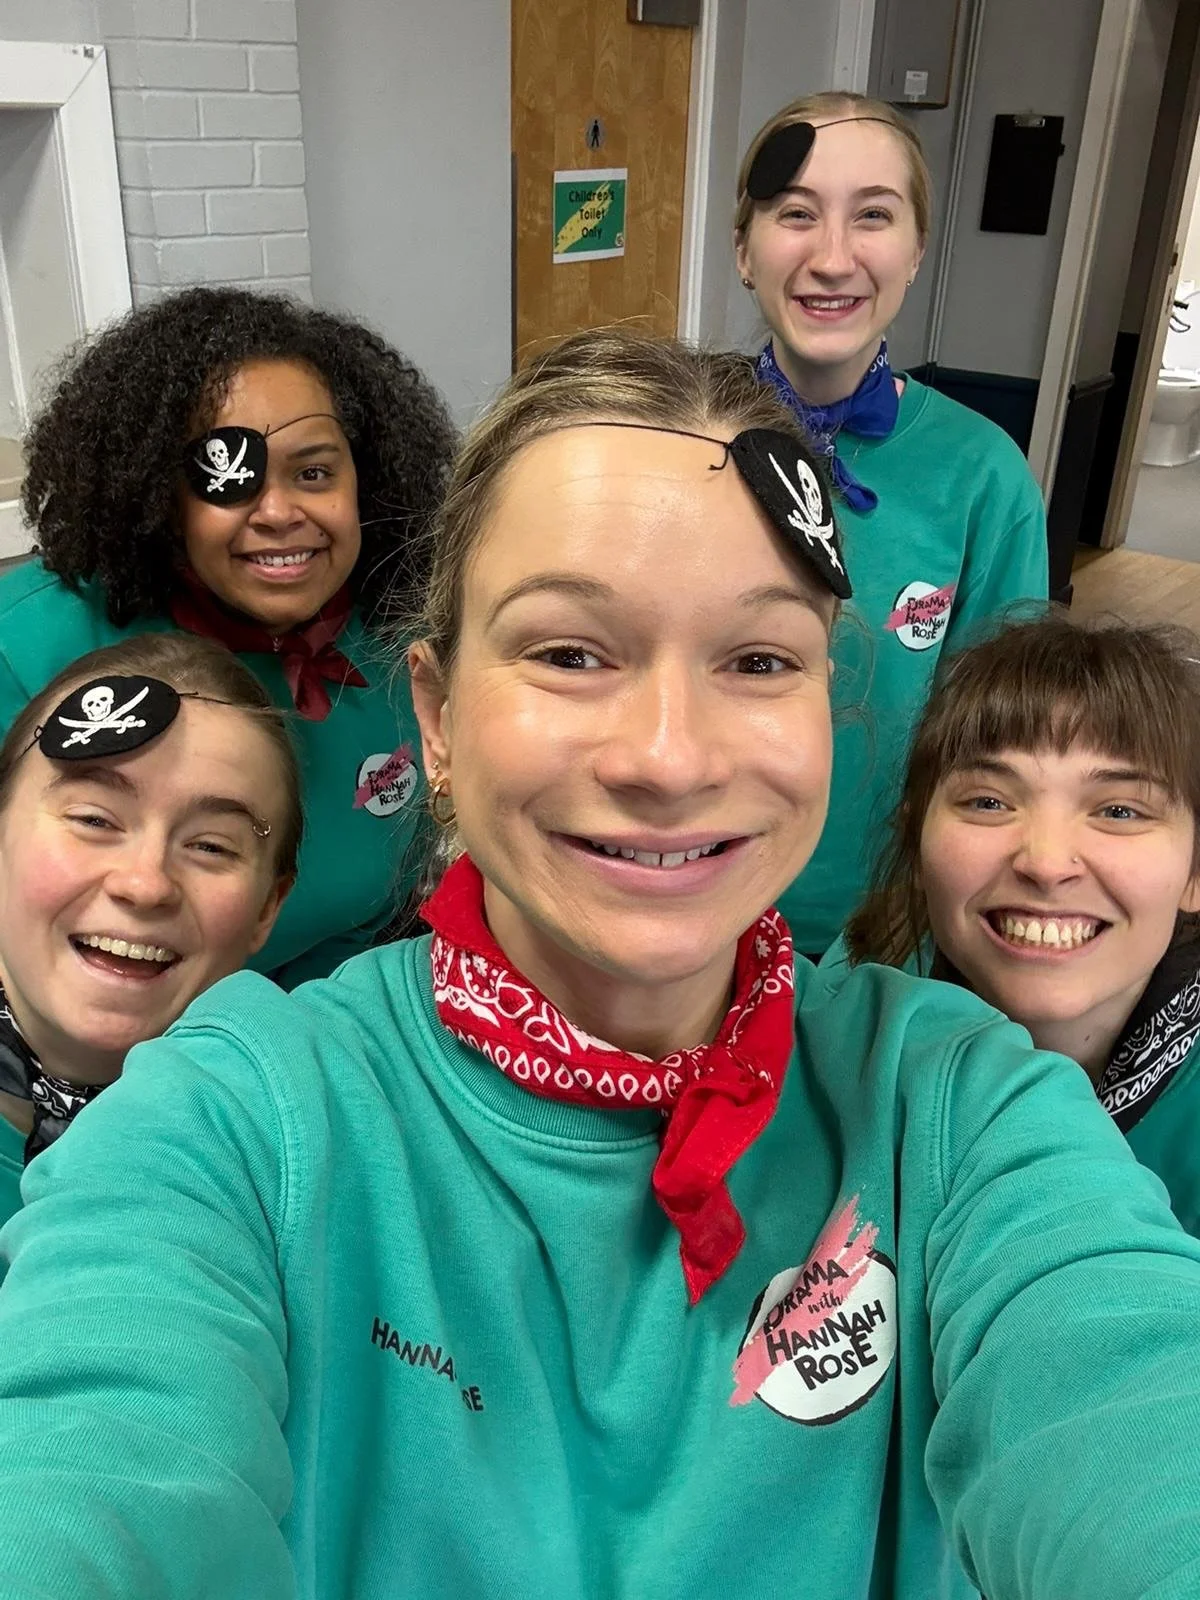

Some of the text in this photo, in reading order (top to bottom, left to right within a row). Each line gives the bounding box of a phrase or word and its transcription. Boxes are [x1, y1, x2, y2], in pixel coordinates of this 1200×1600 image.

[568, 189, 615, 203] Children's
[579, 208, 605, 221] Toilet
[581, 227, 602, 240] Only
[905, 612, 946, 629] HANNAH
[912, 625, 937, 640] ROSE
[379, 789, 405, 806] ROSE
[762, 1258, 849, 1335] DRAMA
[808, 1290, 844, 1314] with
[765, 1299, 887, 1366] HANNAH
[371, 1316, 457, 1382] HANNA
[793, 1331, 879, 1391] ROSE
